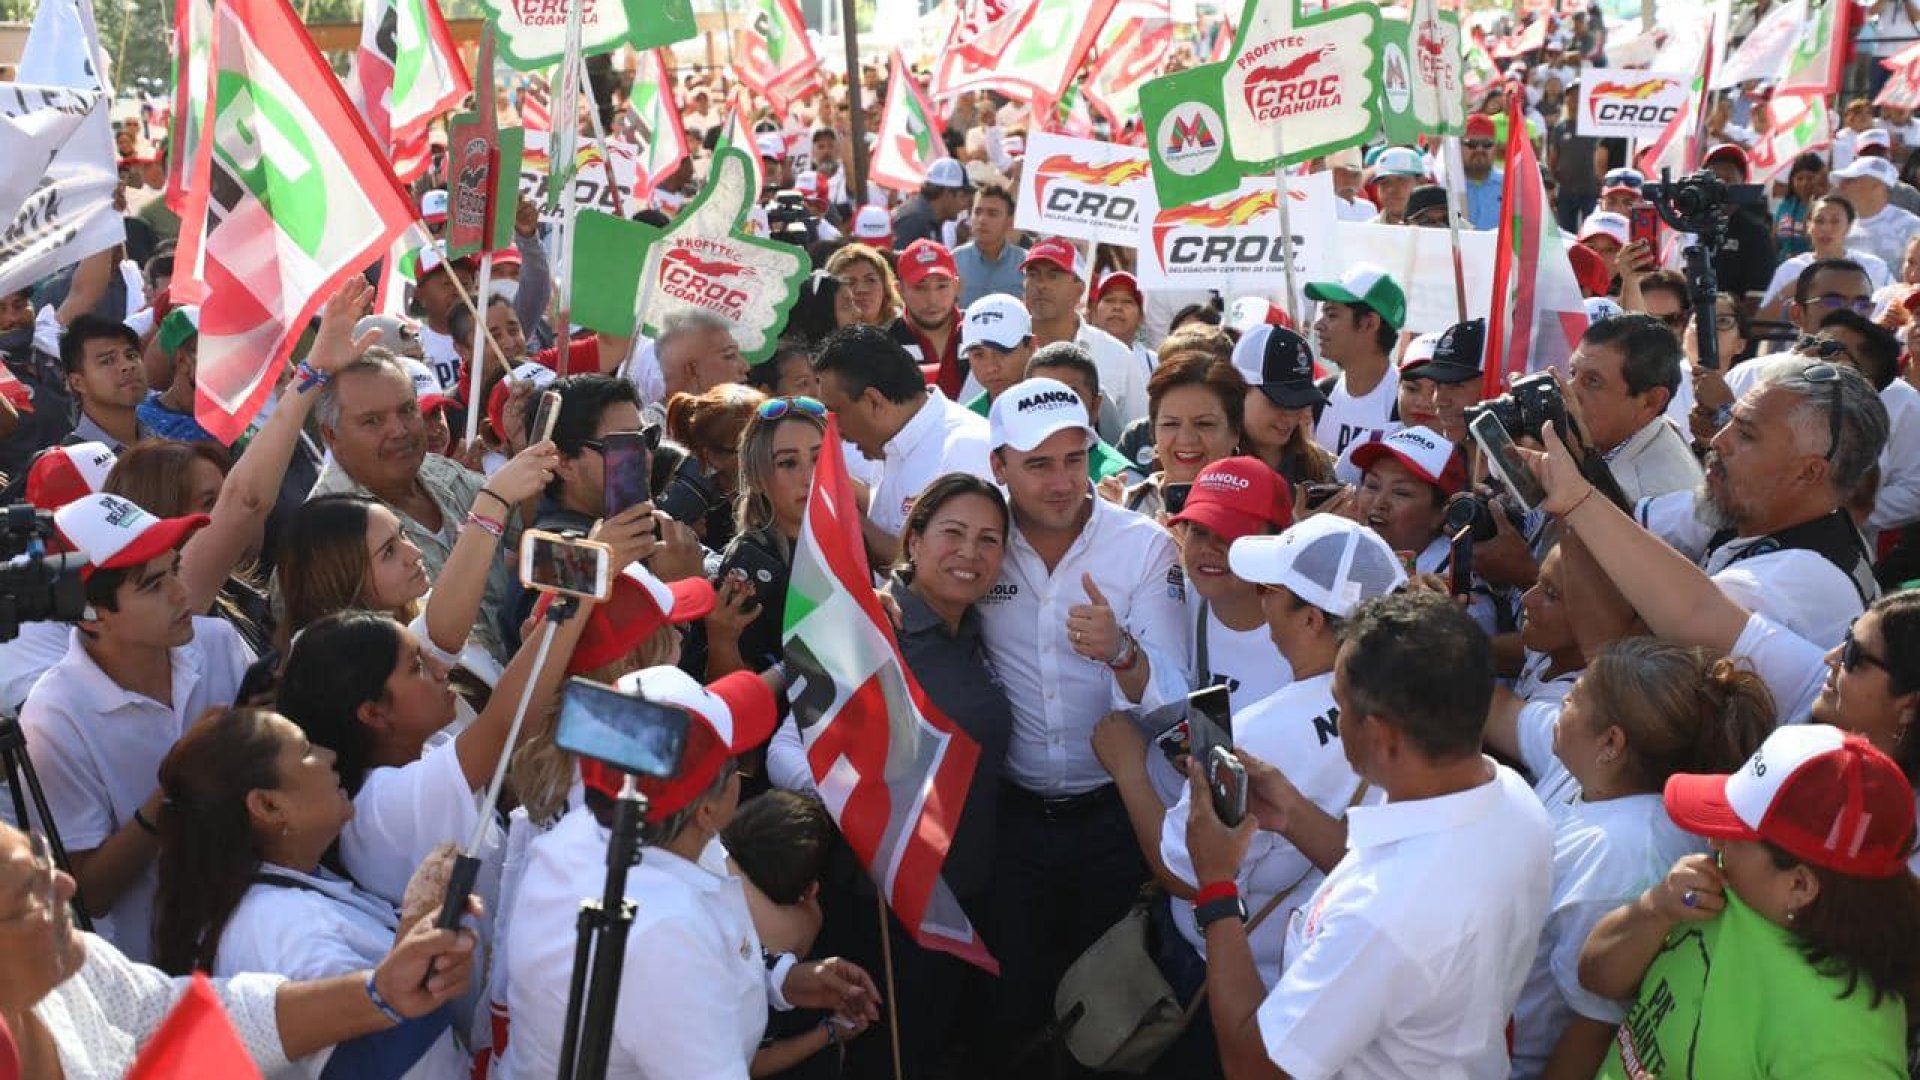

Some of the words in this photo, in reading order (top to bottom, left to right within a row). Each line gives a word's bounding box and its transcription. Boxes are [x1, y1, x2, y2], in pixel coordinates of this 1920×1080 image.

[1237, 36, 1305, 69] PROFYTEC
[1257, 74, 1339, 107] CROC
[1258, 93, 1341, 120] COAHUILA
[1599, 104, 1678, 123] CROC
[1046, 188, 1139, 225] CRO
[1170, 235, 1305, 263] CROC
[663, 284, 742, 321] COAHUILA
[667, 268, 748, 308] CROC
[1018, 392, 1078, 411] MANOLO
[1200, 473, 1249, 488] MANOLO
